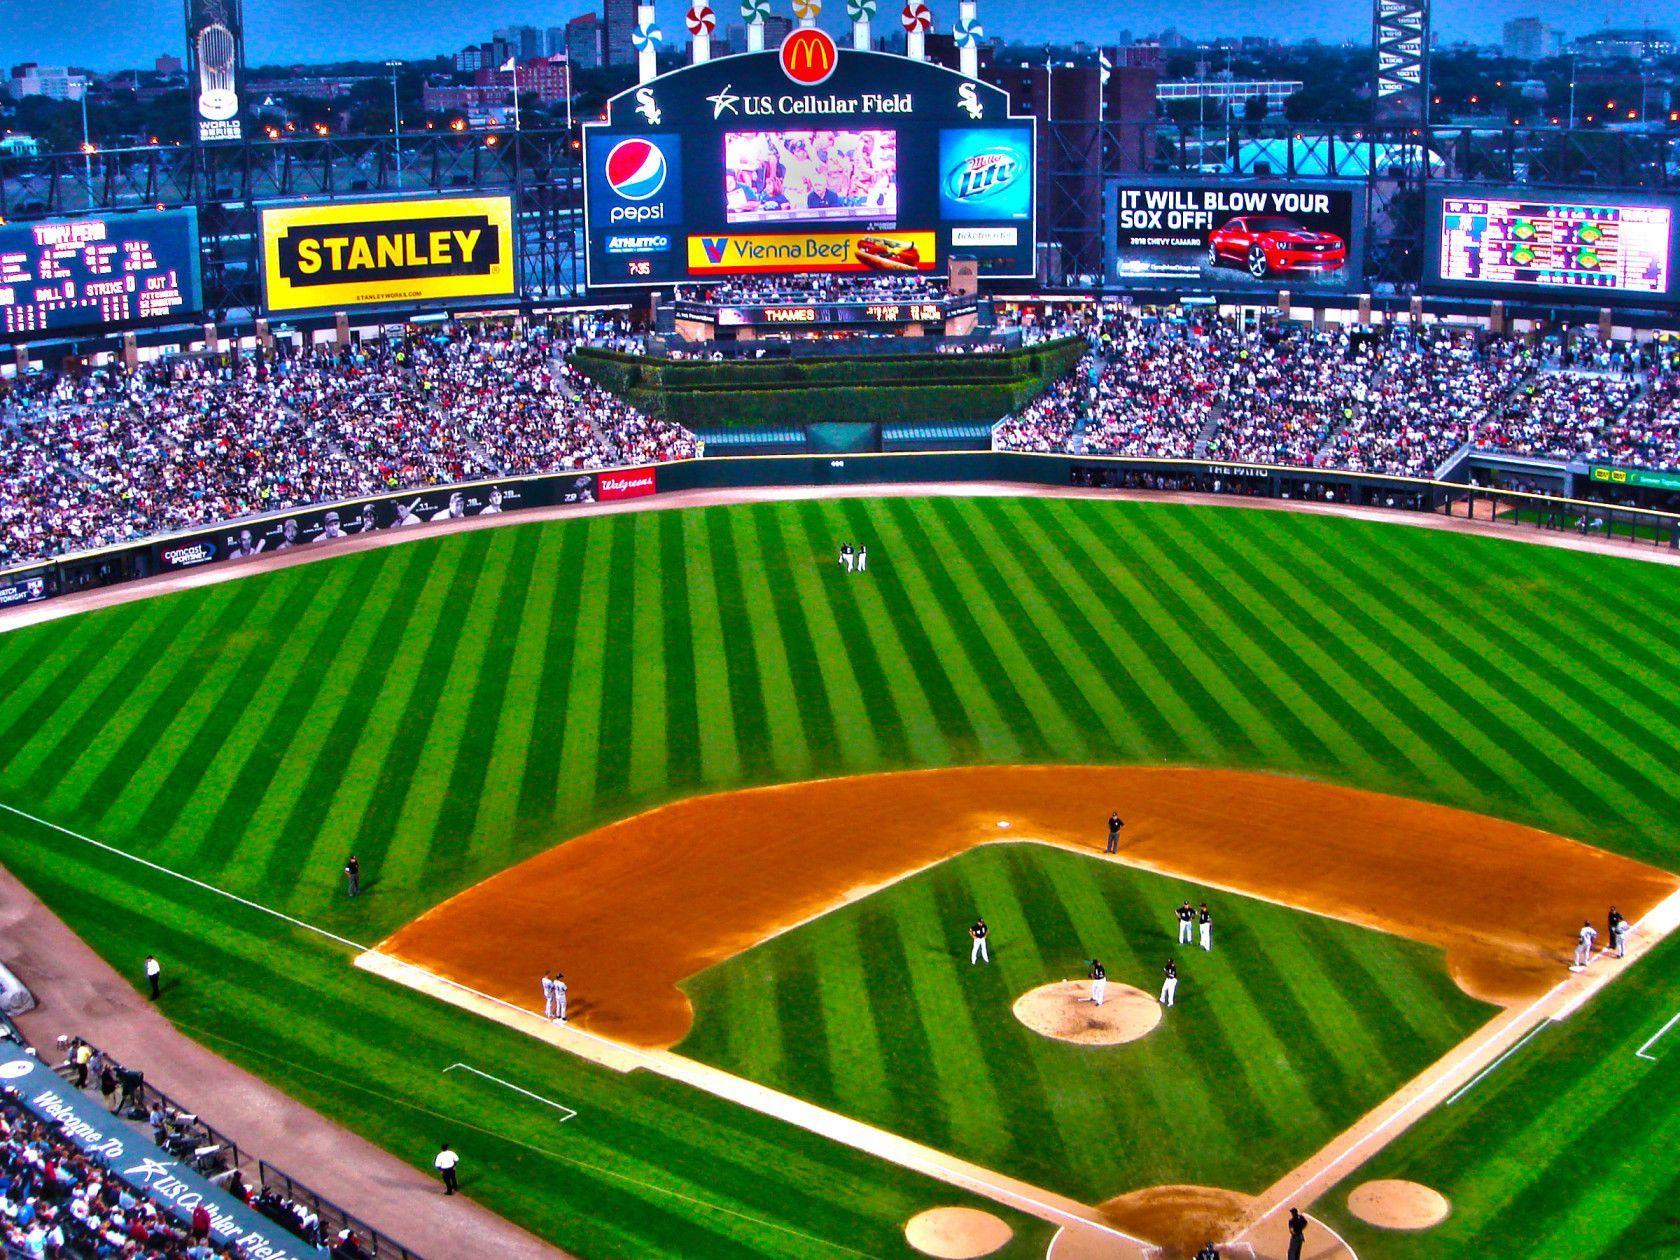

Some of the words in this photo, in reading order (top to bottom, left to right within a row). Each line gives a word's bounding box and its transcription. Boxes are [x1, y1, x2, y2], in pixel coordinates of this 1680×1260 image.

[743, 96, 775, 115] U.S.
[778, 94, 858, 115] Cellular
[861, 93, 913, 113] Field
[199, 120, 241, 129] WORLD
[958, 162, 1016, 199] Lite
[1121, 190, 1141, 209] IT
[1144, 190, 1199, 210] WILL
[1204, 191, 1267, 212] BLOW
[1271, 192, 1330, 213] YOUR
[610, 202, 664, 224] pepsi
[1120, 209, 1163, 229] SOX
[1167, 210, 1213, 230] OFF!
[297, 229, 482, 274] STANLEY
[734, 240, 802, 258] Vienna
[806, 238, 850, 263] Beef
[1146, 237, 1170, 246] CHEVY
[1170, 238, 1201, 246] CAMARO
[86, 281, 124, 296] STRIKE
[147, 276, 166, 290] OUT
[765, 308, 815, 322] THAMES
[1209, 466, 1231, 475] THE
[601, 476, 653, 492] Walgreens
[164, 544, 202, 560] comcast
[0, 586, 17, 597] ATCH
[33, 1090, 103, 1142] Welcome
[97, 1137, 124, 1158] To
